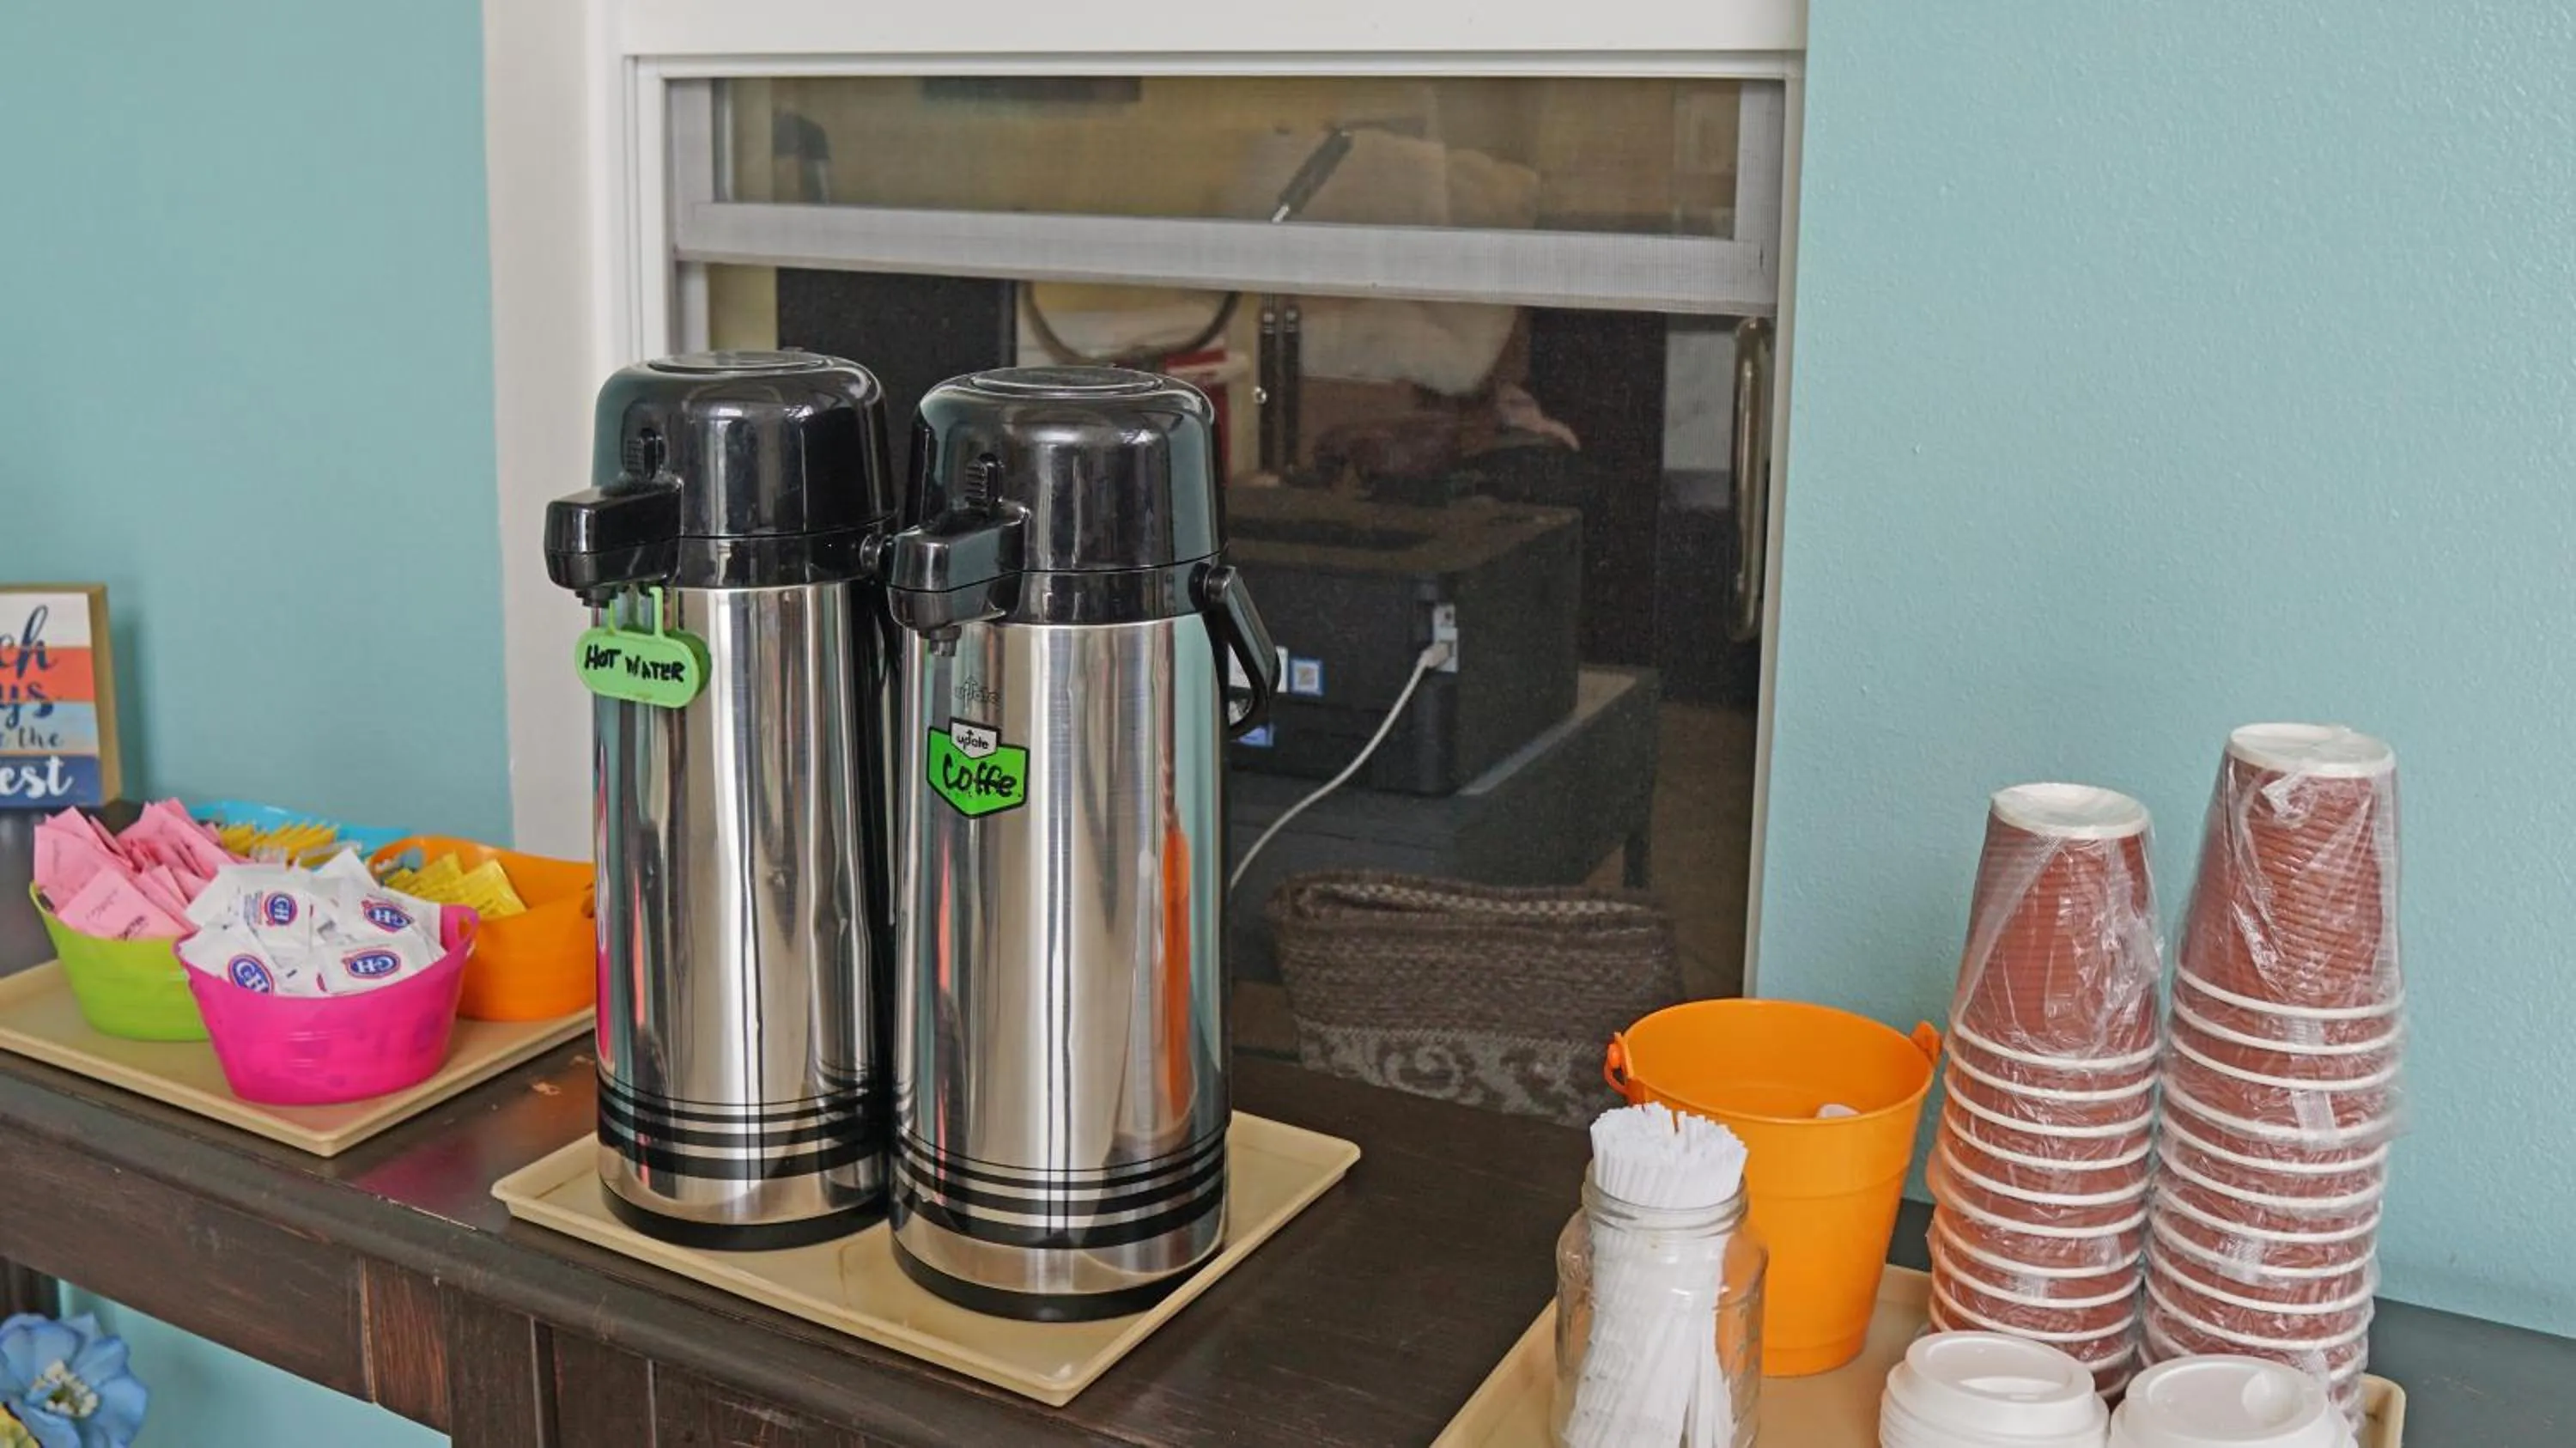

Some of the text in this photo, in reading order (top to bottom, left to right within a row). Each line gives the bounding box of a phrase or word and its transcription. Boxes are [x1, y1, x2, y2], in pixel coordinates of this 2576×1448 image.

[584, 643, 686, 683] HOT WATER
[18, 727, 63, 749] the
[942, 752, 1018, 798] Coffe
